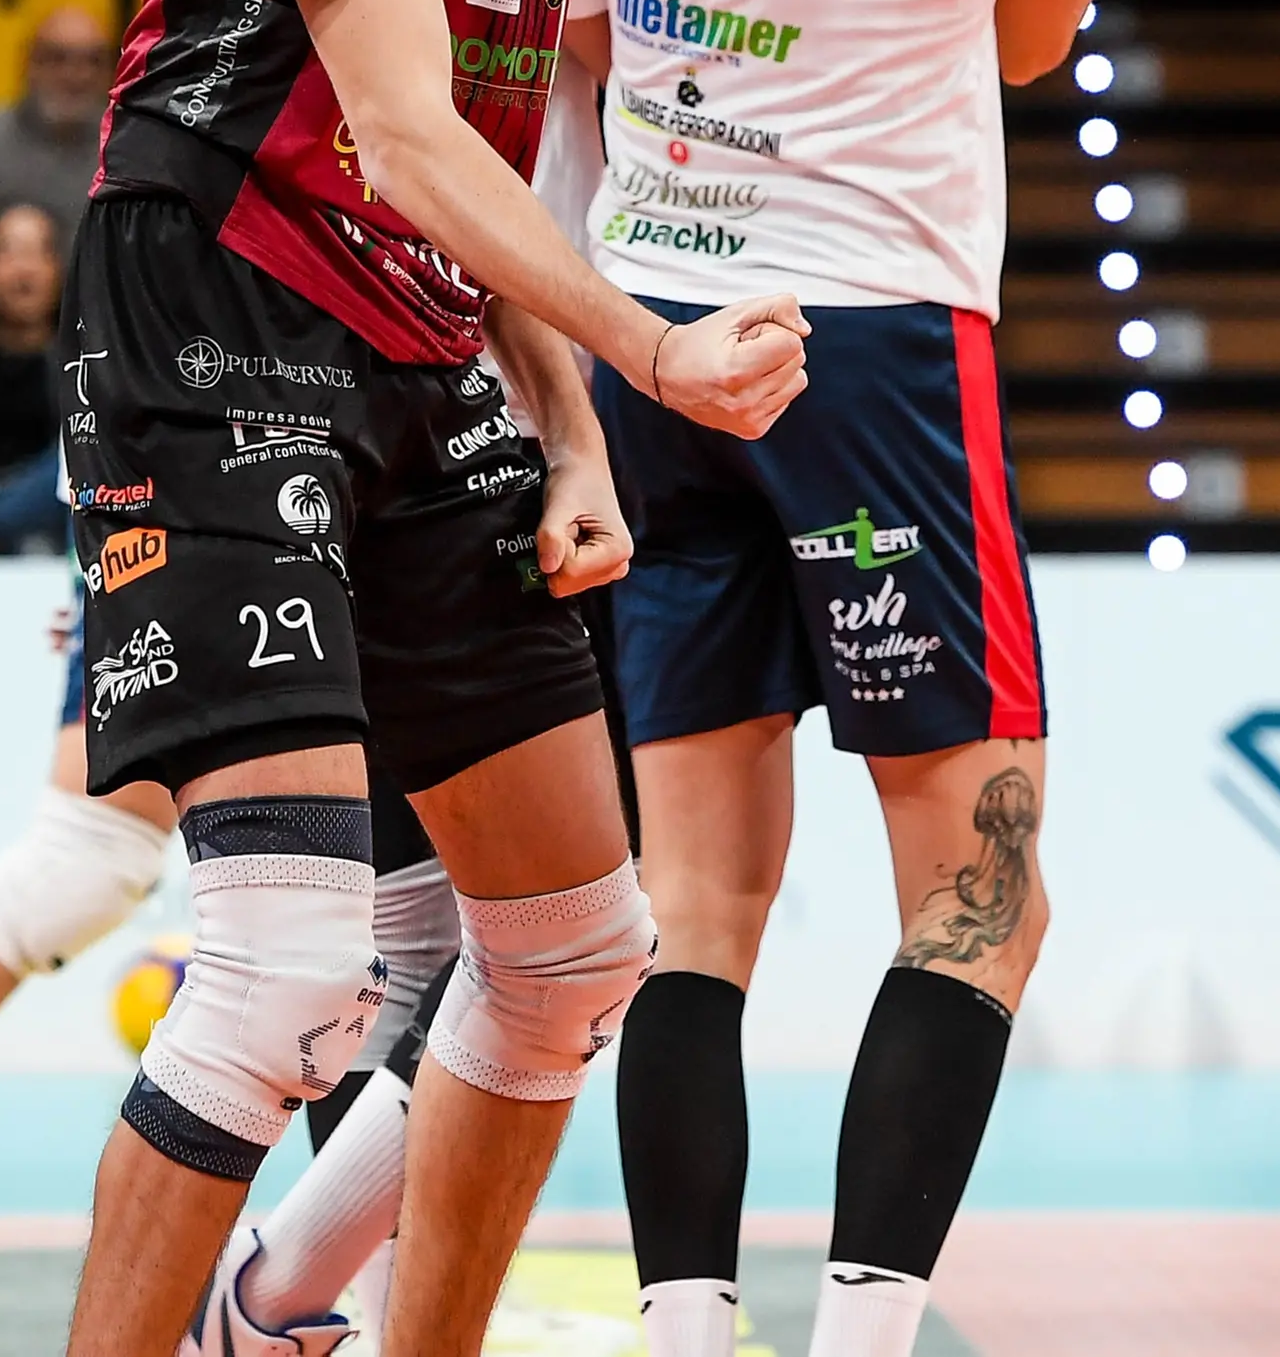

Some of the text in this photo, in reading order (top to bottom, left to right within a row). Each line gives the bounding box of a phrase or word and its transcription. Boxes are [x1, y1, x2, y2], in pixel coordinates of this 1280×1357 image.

[179, 16, 255, 127] CONSULTING
[451, 33, 560, 84] OMOT
[626, 218, 747, 260] packly
[225, 405, 332, 429] impresa edile
[220, 448, 272, 473] general
[105, 531, 162, 581] hub
[238, 597, 325, 669] 29
[864, 630, 944, 662] village
[111, 658, 179, 706] WIND
[898, 661, 936, 679] SPA
